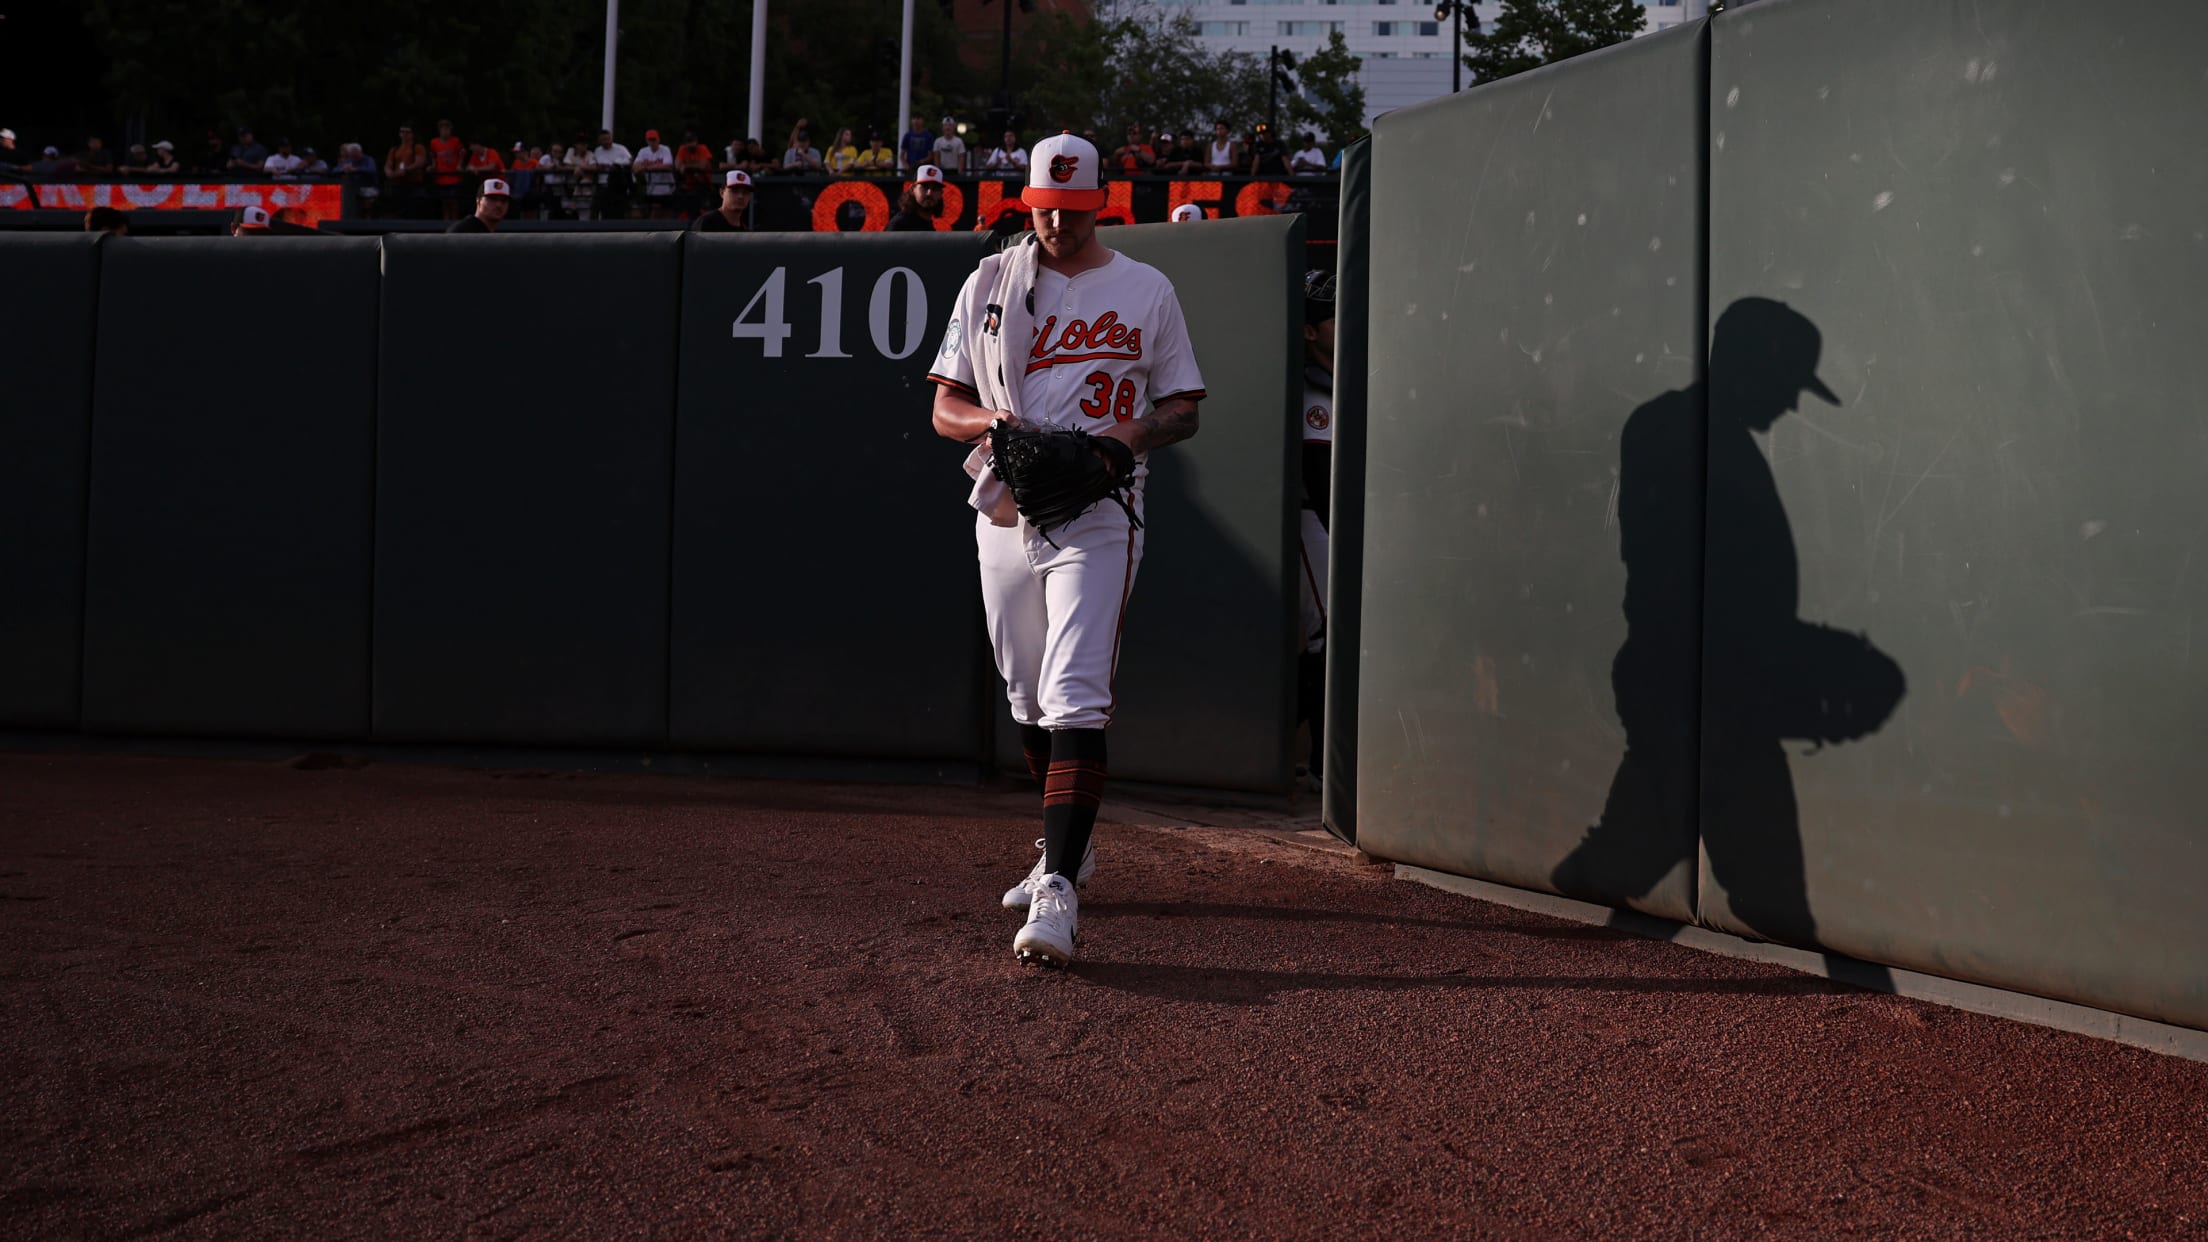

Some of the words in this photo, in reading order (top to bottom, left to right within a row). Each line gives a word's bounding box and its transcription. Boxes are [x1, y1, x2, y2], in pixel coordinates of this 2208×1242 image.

[732, 266, 928, 360] 410
[1029, 311, 1142, 360] ioles
[1080, 371, 1136, 424] 38
